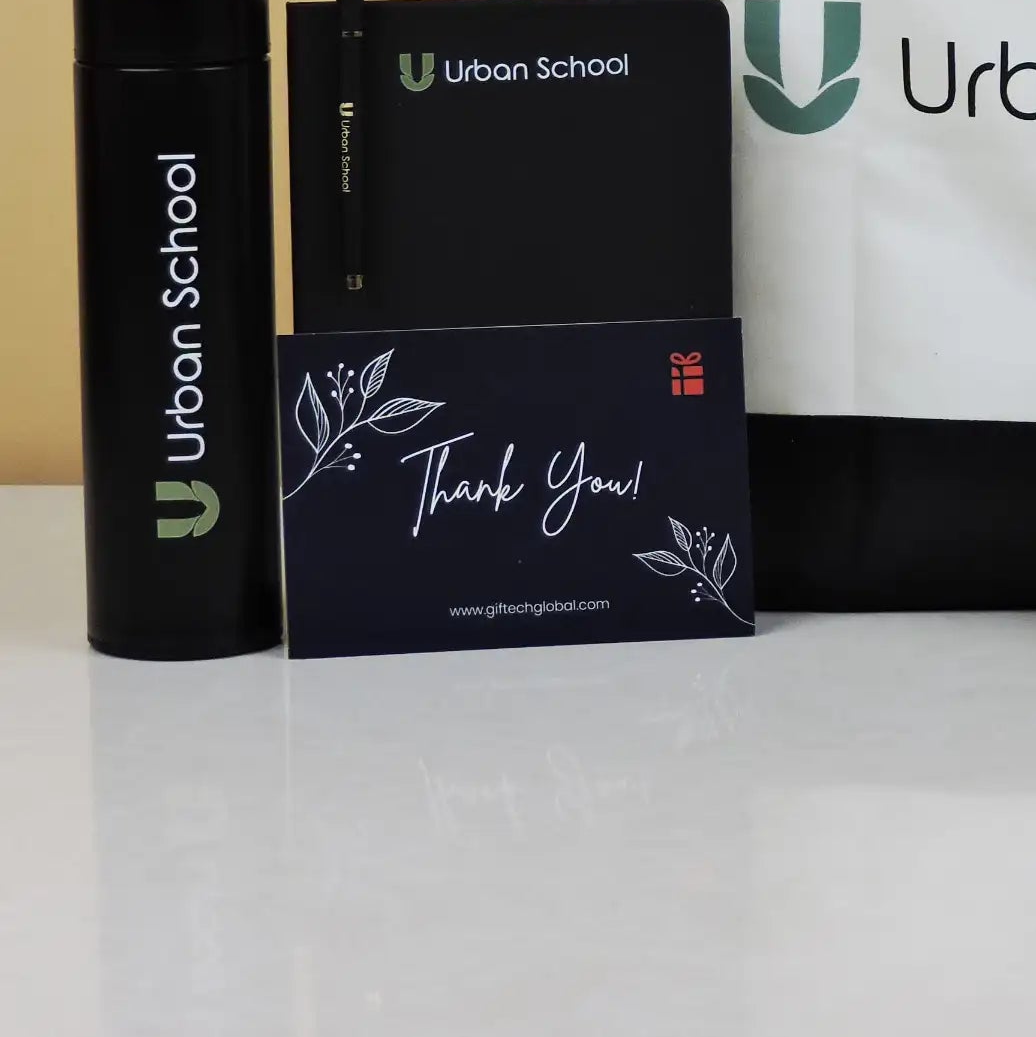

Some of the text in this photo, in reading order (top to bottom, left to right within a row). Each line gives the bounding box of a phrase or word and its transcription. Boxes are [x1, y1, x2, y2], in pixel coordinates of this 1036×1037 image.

[445, 58, 529, 83] Urban
[536, 53, 629, 80] School
[341, 120, 351, 153] Urban
[341, 156, 351, 193] School
[157, 153, 201, 309] School
[165, 323, 206, 462] Urban
[400, 431, 643, 538] Thank You!
[449, 599, 610, 619] www.giftechglobal.com
